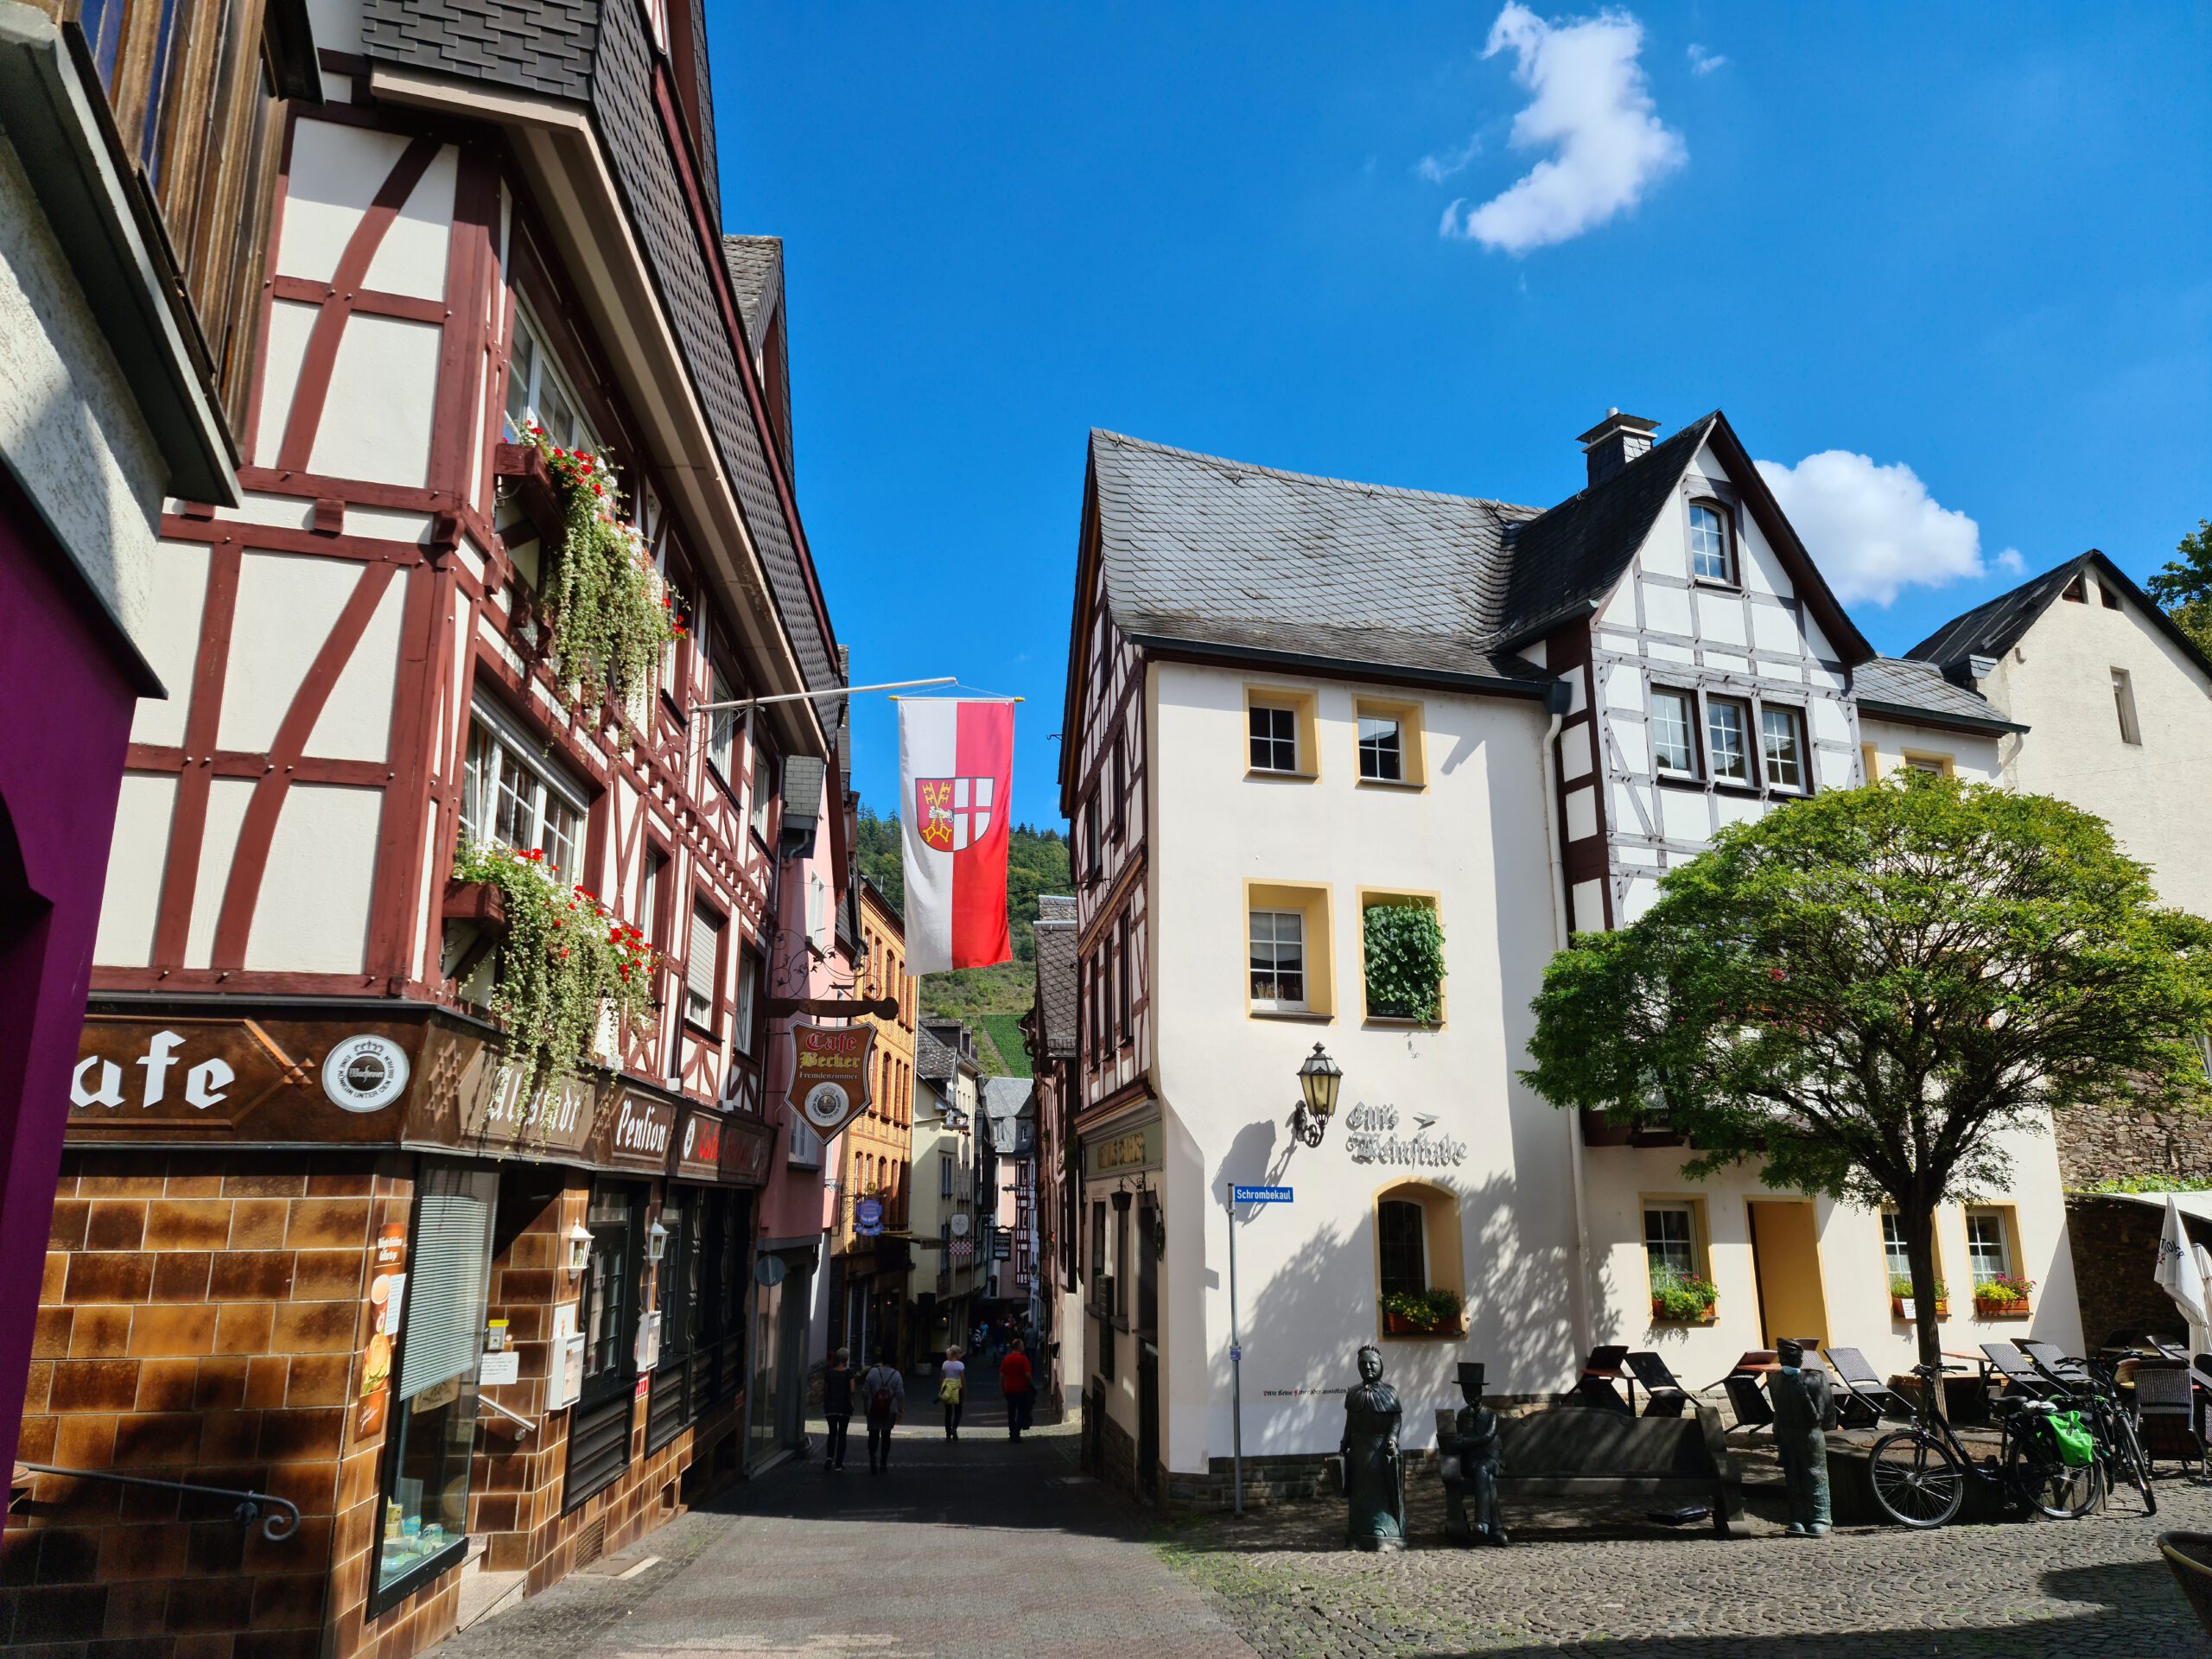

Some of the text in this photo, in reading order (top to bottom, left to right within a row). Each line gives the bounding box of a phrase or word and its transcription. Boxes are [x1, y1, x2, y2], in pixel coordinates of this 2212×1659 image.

[806, 1031, 857, 1053] Cafe
[70, 1030, 235, 1109] afe
[799, 1051, 861, 1069] Becker
[337, 1054, 395, 1099] EINE KÖNIGIN UNTER DEN BIEREN
[1236, 1189, 1291, 1200] Schrombekaul
